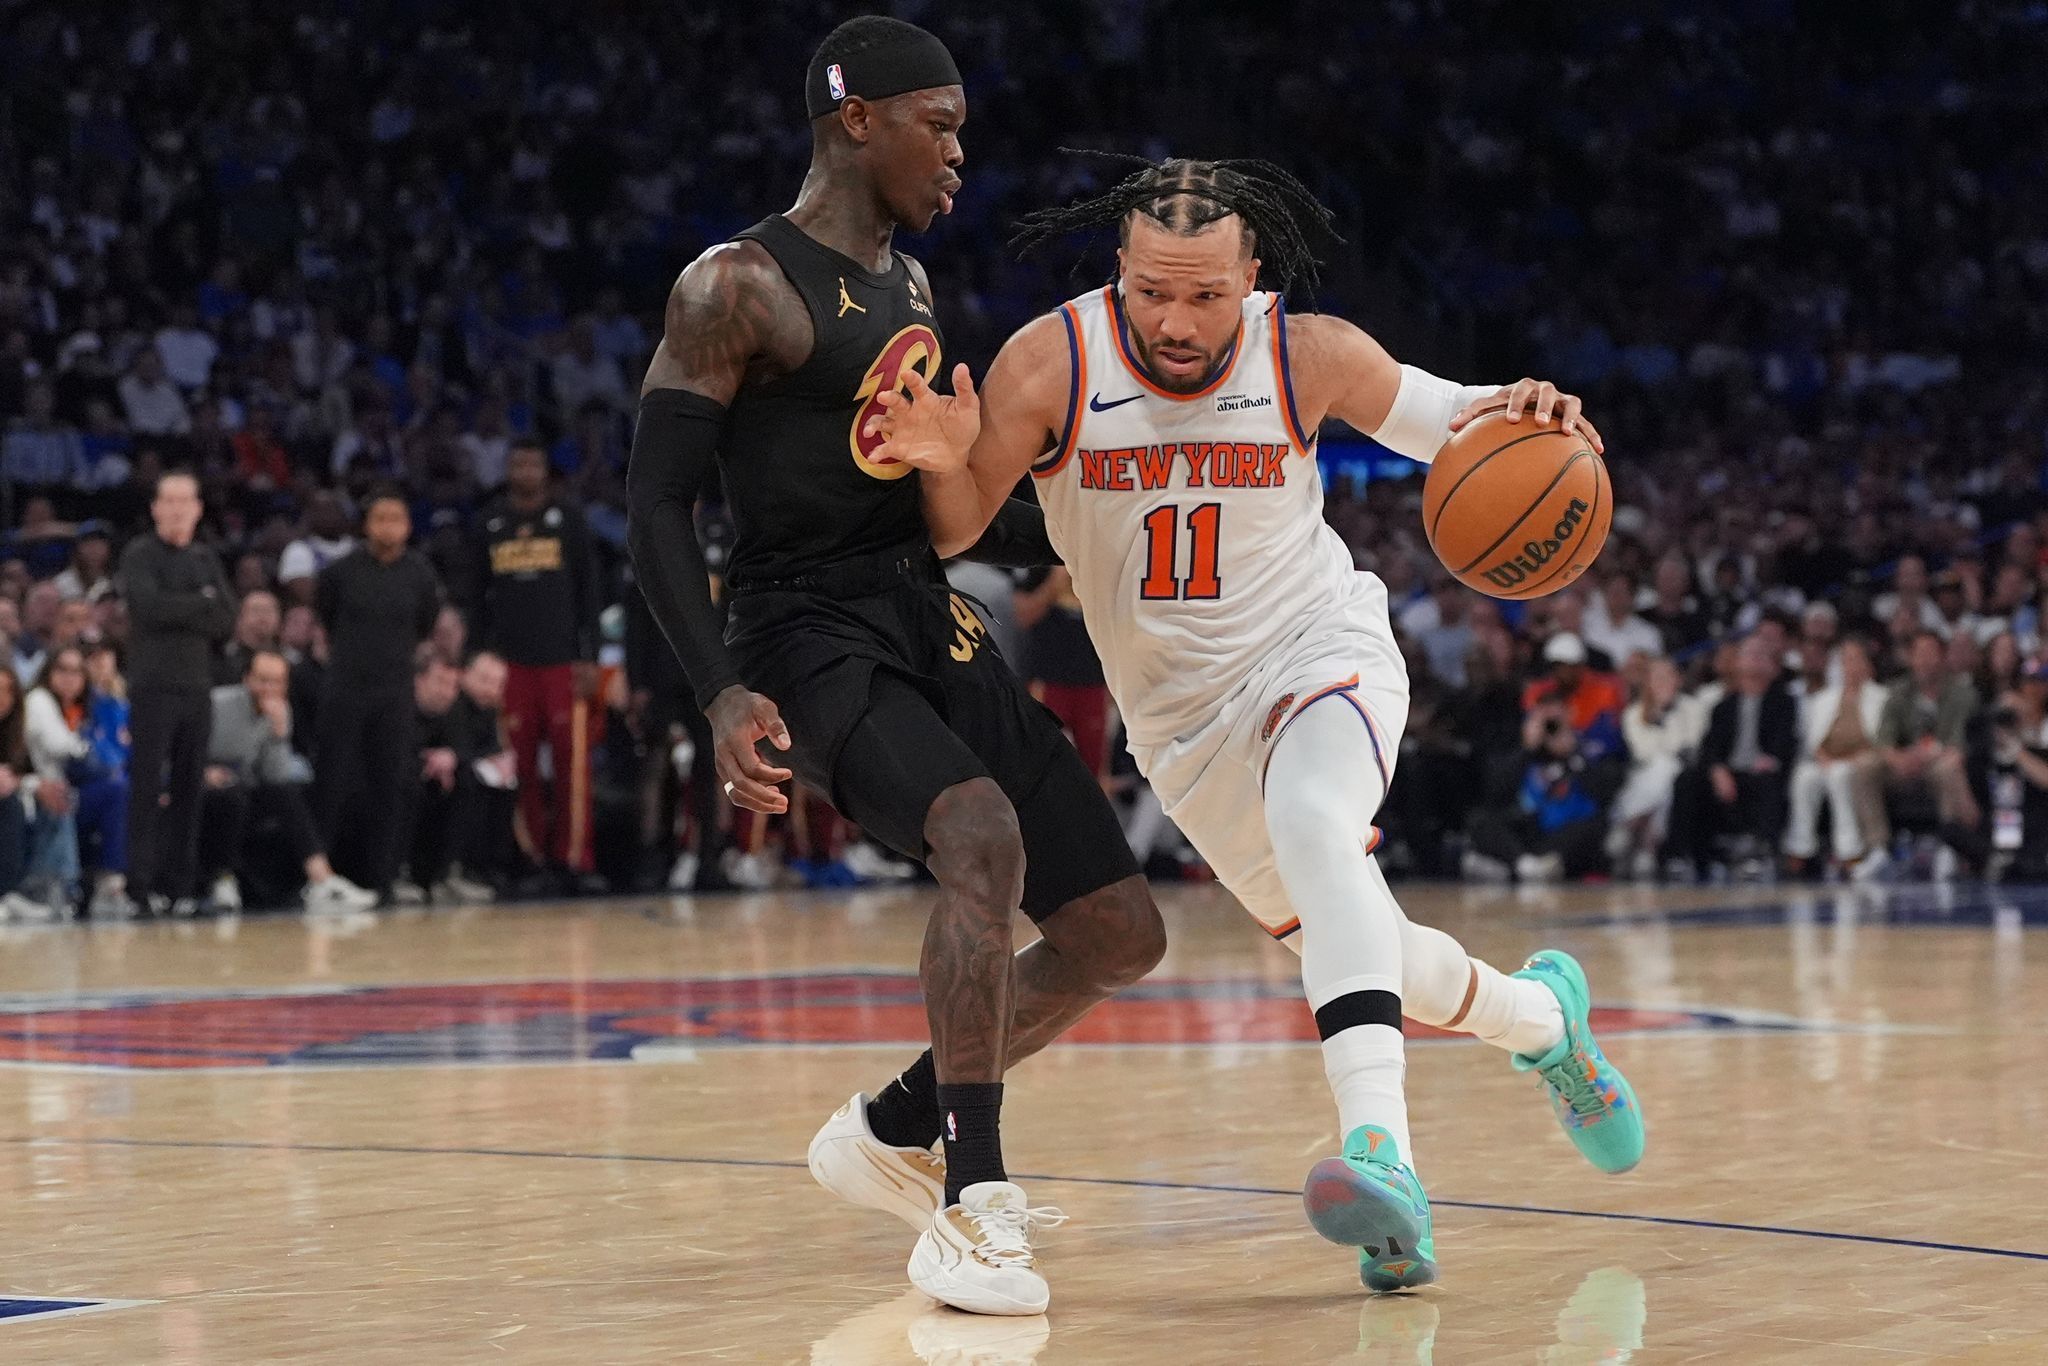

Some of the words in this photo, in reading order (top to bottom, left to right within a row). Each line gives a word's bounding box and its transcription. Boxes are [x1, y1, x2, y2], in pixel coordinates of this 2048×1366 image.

[1217, 401, 1238, 411] abu
[1240, 395, 1271, 409] dhabi
[1078, 444, 1178, 490] NEW
[1181, 443, 1289, 488] YORK
[1140, 503, 1221, 600] 11
[1480, 497, 1588, 588] Wilson
